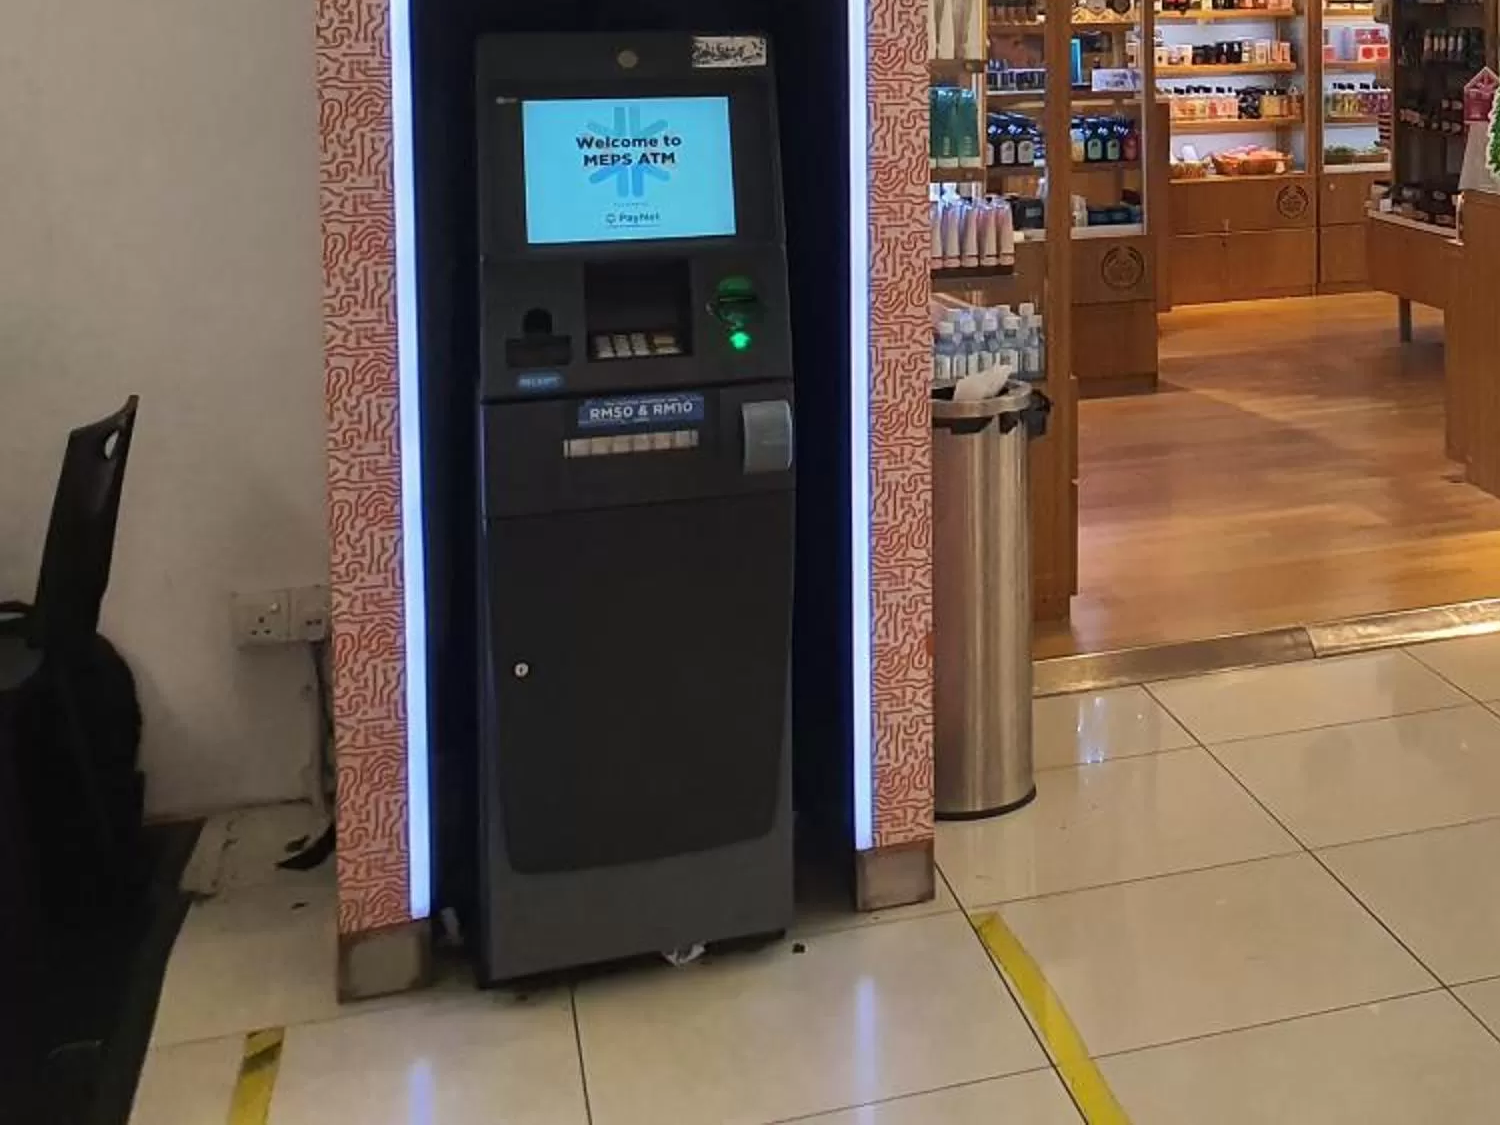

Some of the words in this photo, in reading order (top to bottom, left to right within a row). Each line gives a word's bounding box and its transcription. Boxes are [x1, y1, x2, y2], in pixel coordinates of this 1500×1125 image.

[576, 135, 659, 150] Welcome
[663, 134, 682, 147] to
[583, 153, 633, 167] MEPS
[638, 151, 675, 165] ATM
[589, 405, 634, 421] RM50
[638, 405, 649, 417] &
[653, 401, 693, 416] RM10
